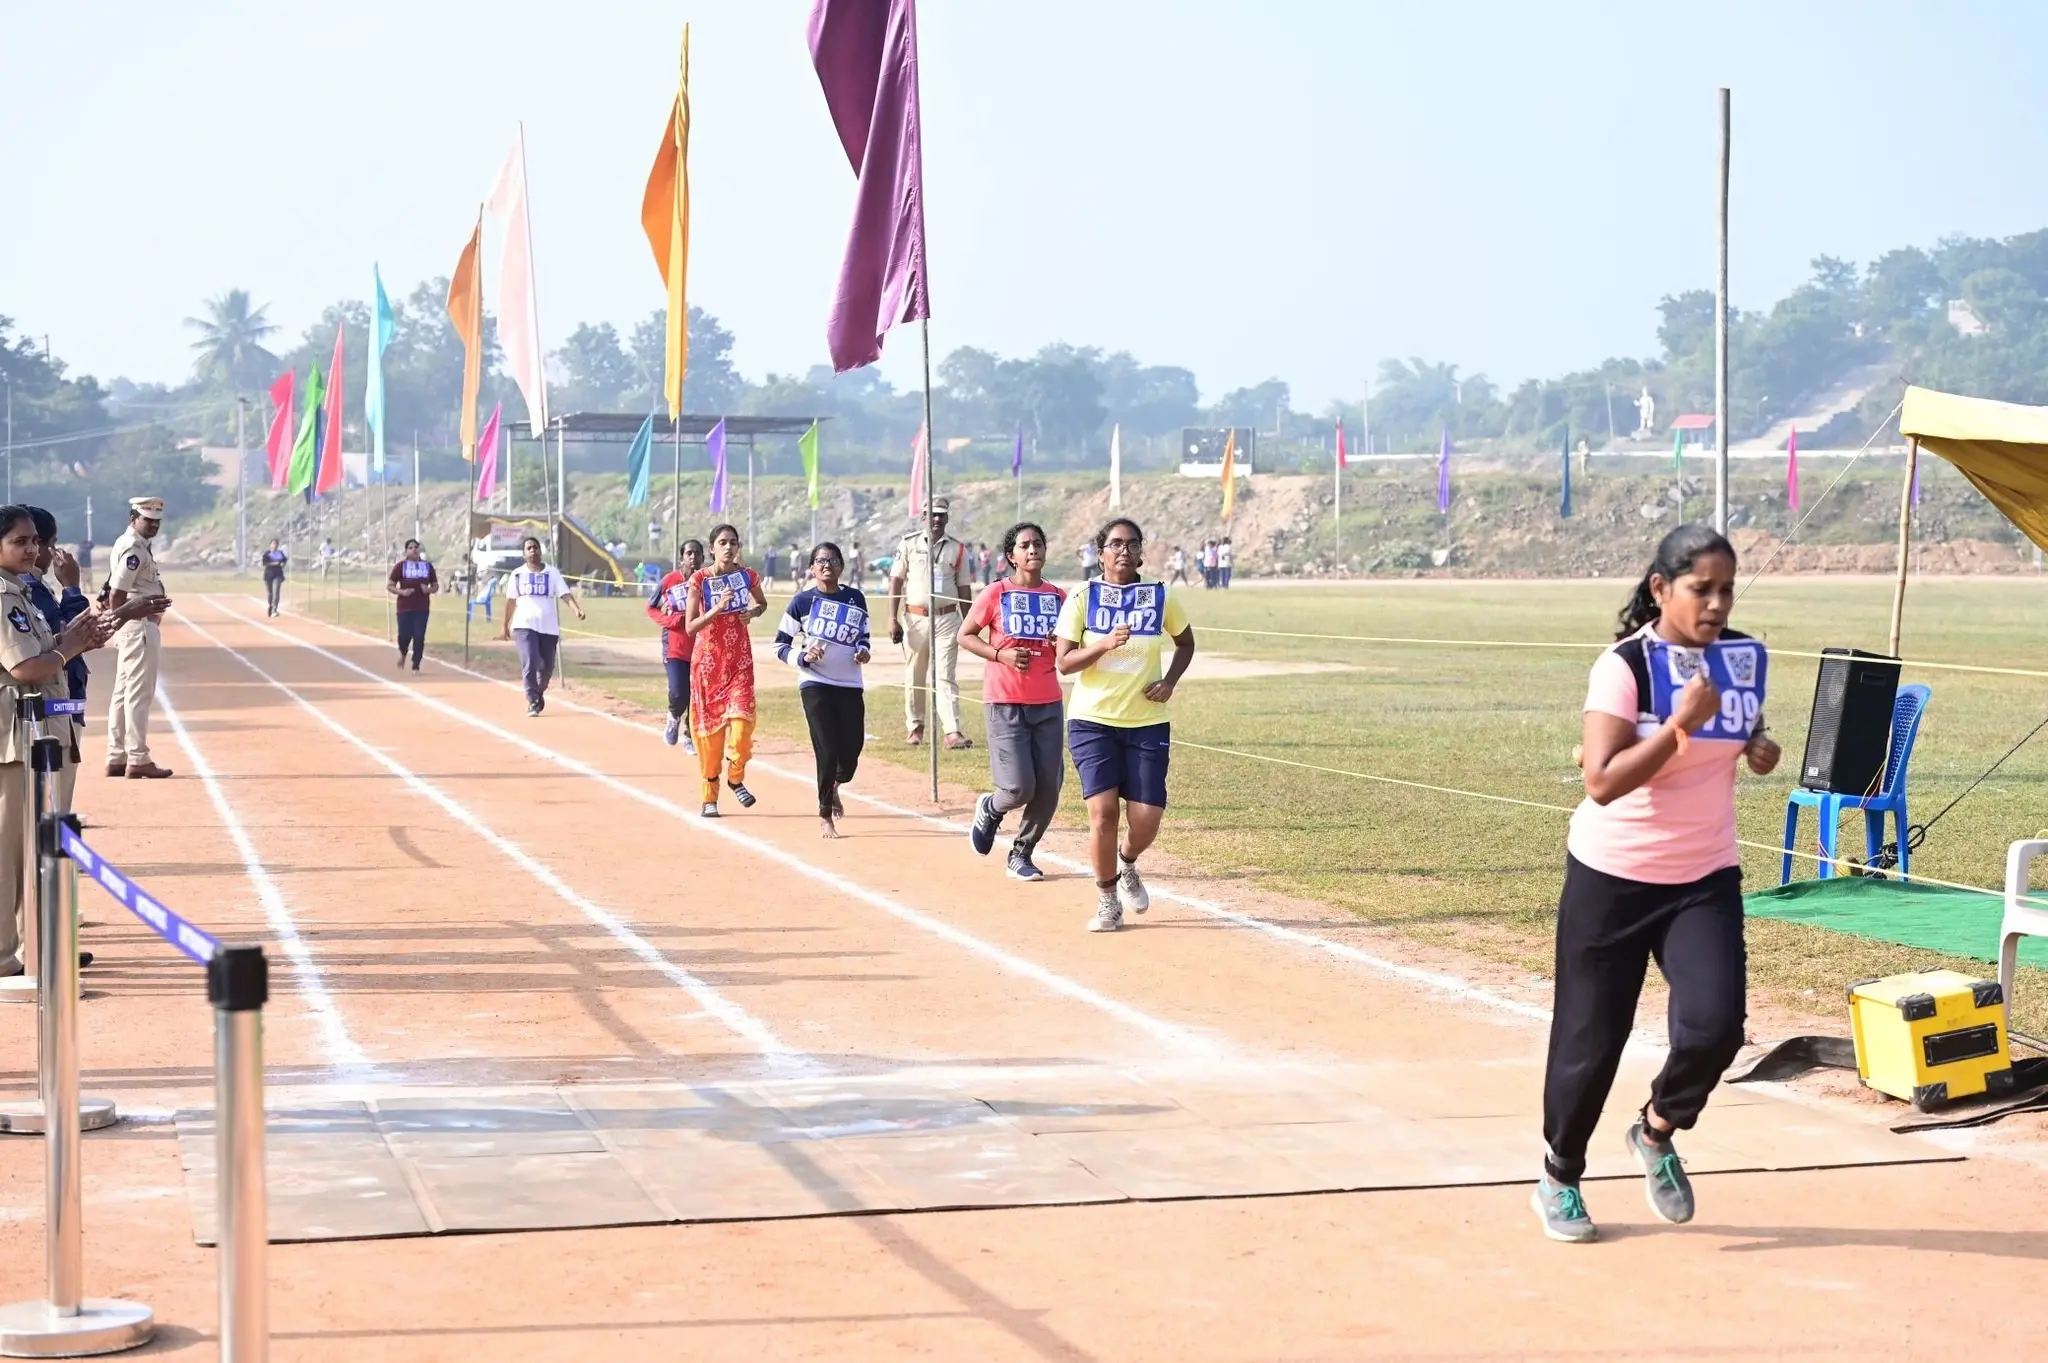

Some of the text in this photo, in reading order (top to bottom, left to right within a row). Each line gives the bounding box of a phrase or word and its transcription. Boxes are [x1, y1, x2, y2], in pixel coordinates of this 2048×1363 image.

[710, 588, 749, 610] 038
[811, 617, 860, 644] 0863
[1095, 607, 1157, 632] 0402
[1670, 688, 1759, 736] 99
